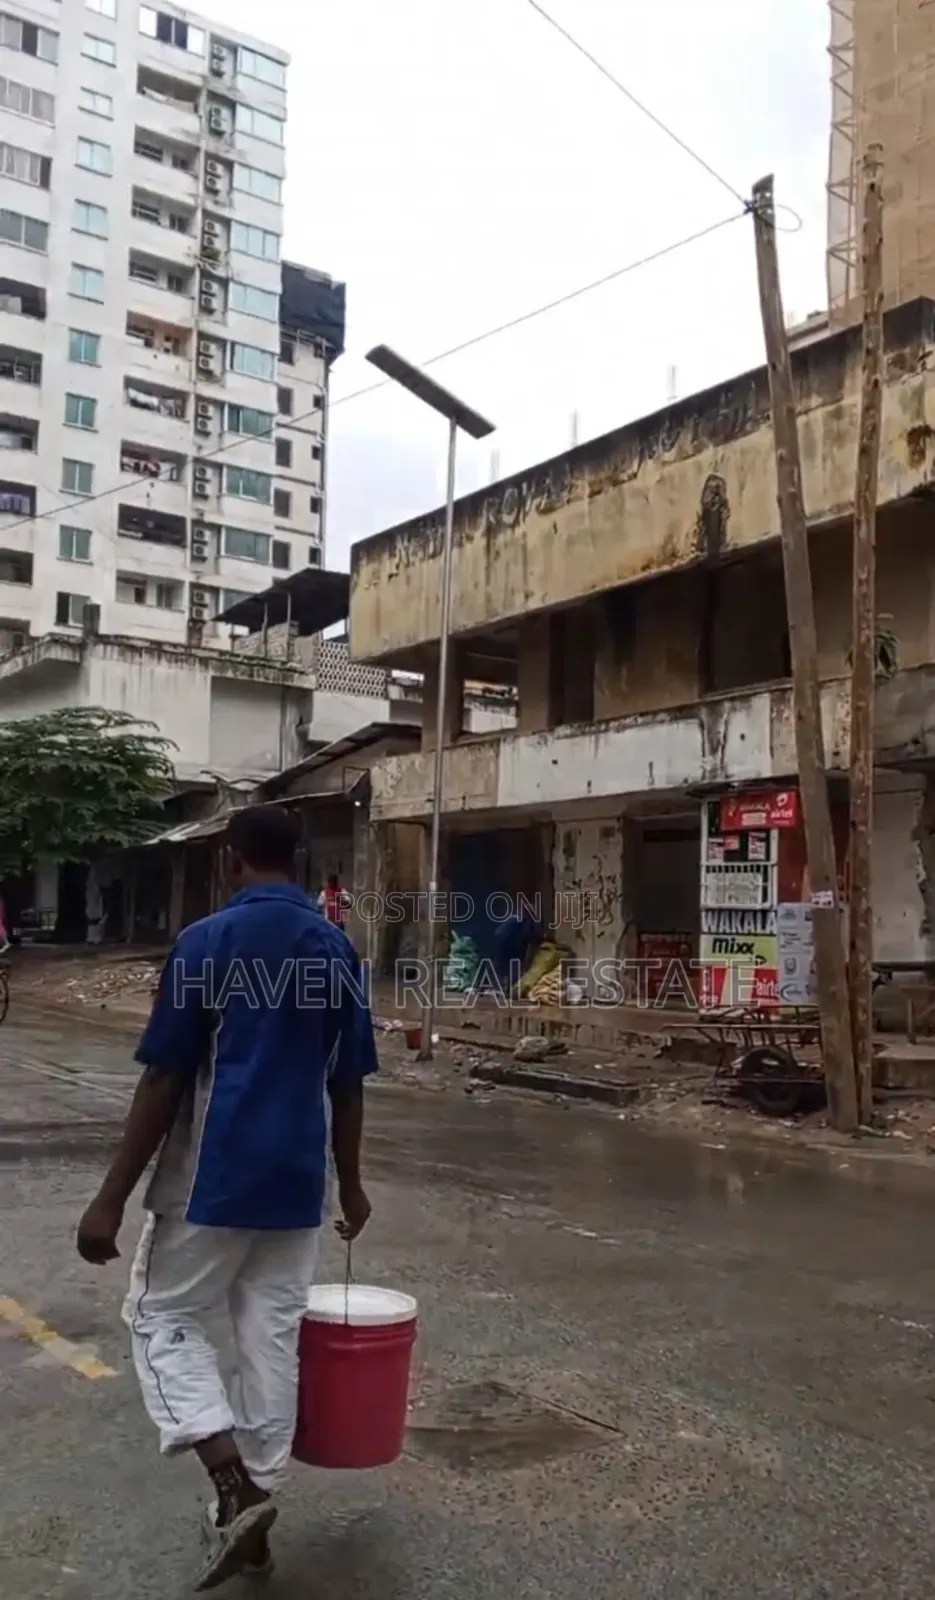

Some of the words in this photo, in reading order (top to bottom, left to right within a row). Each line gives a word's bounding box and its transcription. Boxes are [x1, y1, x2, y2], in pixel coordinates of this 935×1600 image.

[771, 808, 793, 819] airtel
[702, 908, 777, 935] WAKALA
[712, 937, 755, 955] mixx
